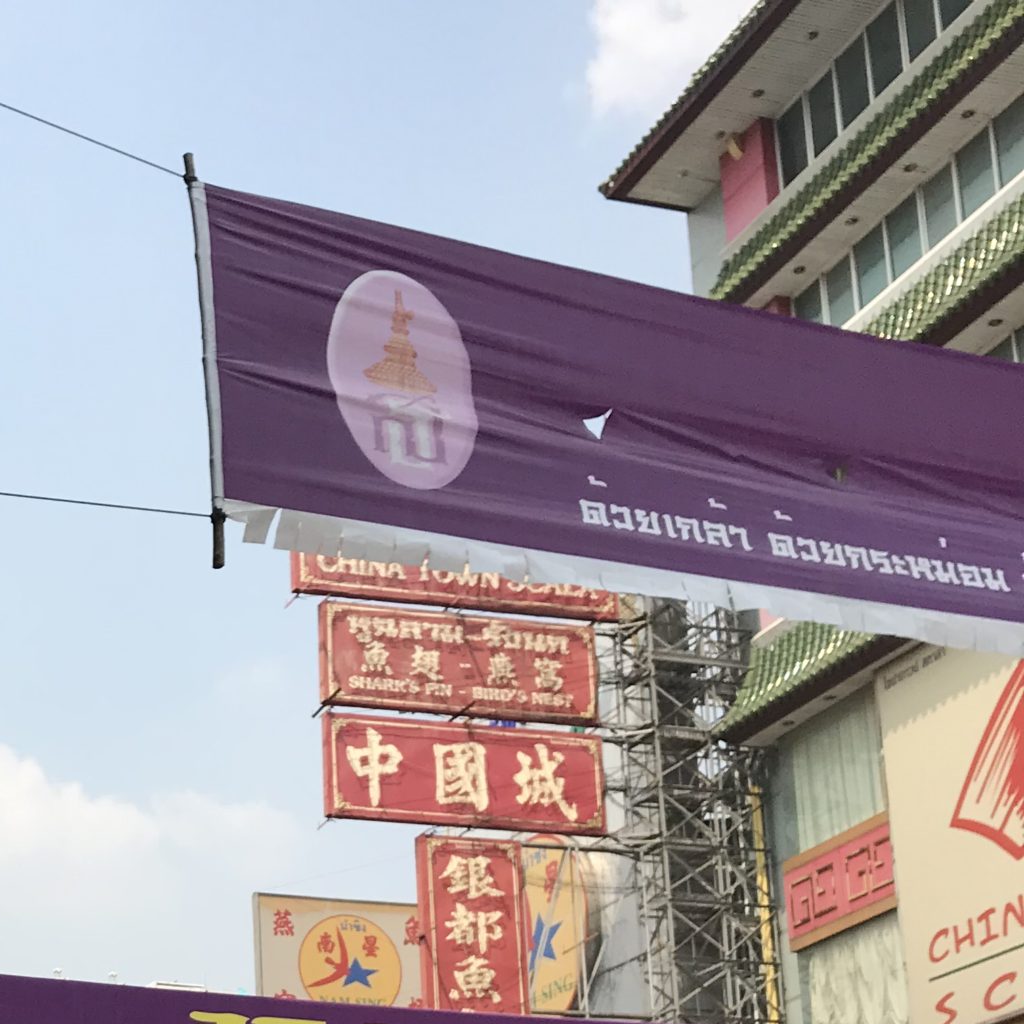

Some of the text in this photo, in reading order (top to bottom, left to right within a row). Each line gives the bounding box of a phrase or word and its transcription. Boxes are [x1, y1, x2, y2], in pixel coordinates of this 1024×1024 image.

[531, 691, 574, 708] NEST
[345, 727, 578, 822] 中國城
[438, 854, 506, 1013] 銀都魚
